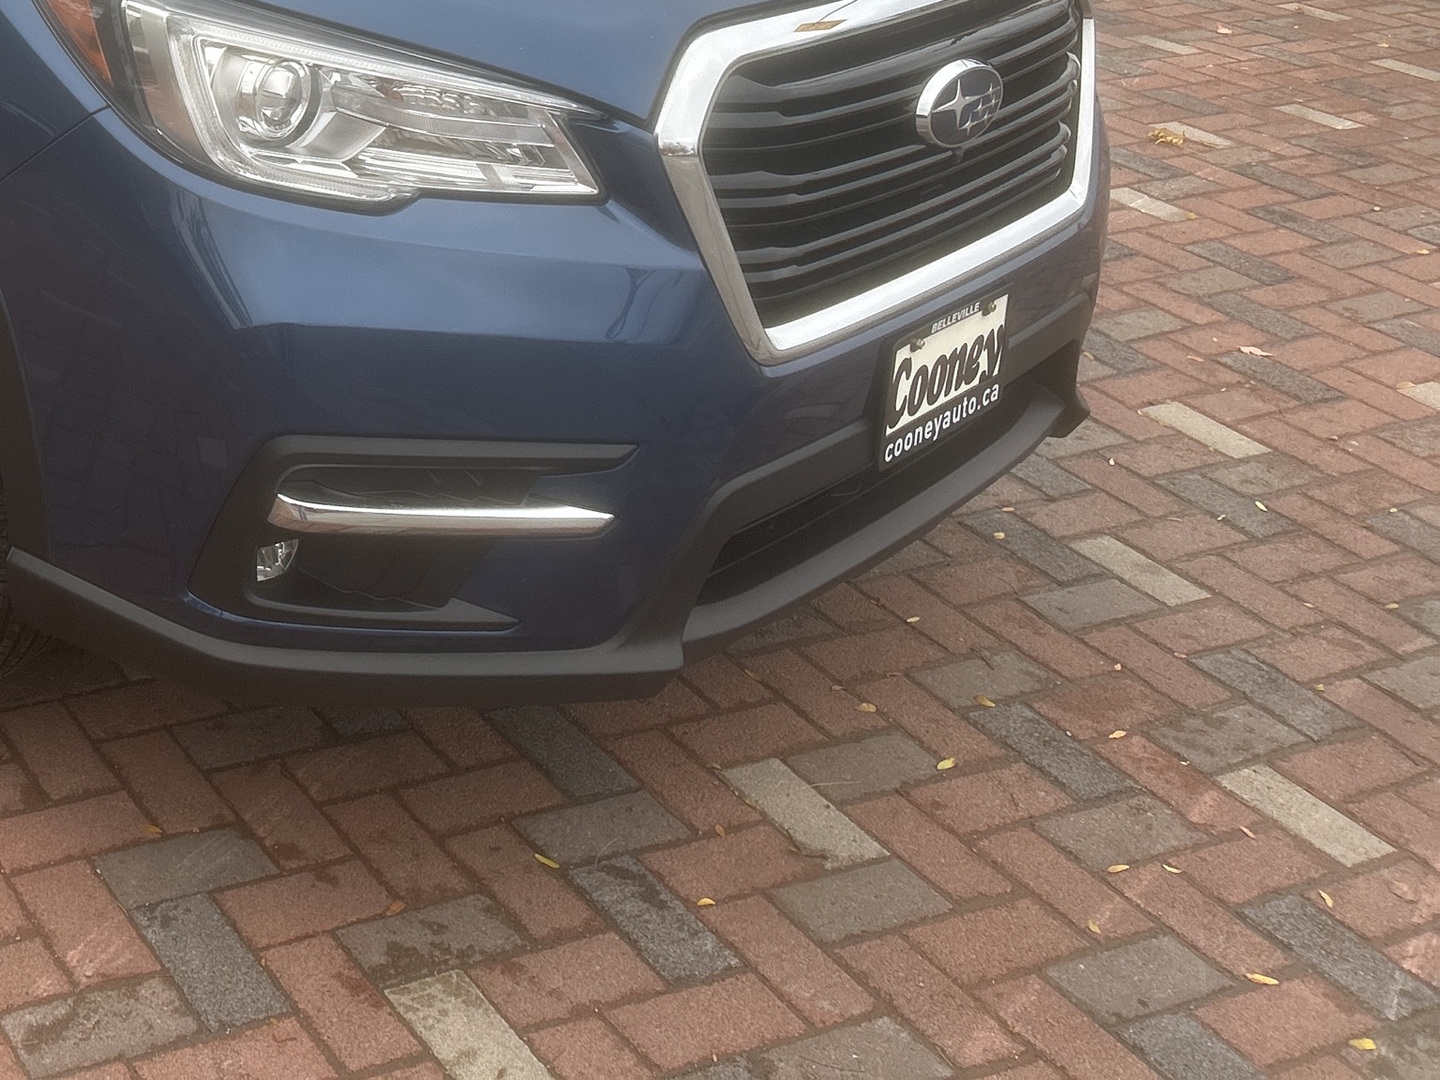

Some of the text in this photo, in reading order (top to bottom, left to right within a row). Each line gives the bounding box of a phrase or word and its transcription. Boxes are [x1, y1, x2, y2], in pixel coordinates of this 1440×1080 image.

[931, 302, 981, 334] BELLEVILLE
[886, 324, 1005, 430] Cooney
[884, 383, 1000, 463] cooneyauto.ca
